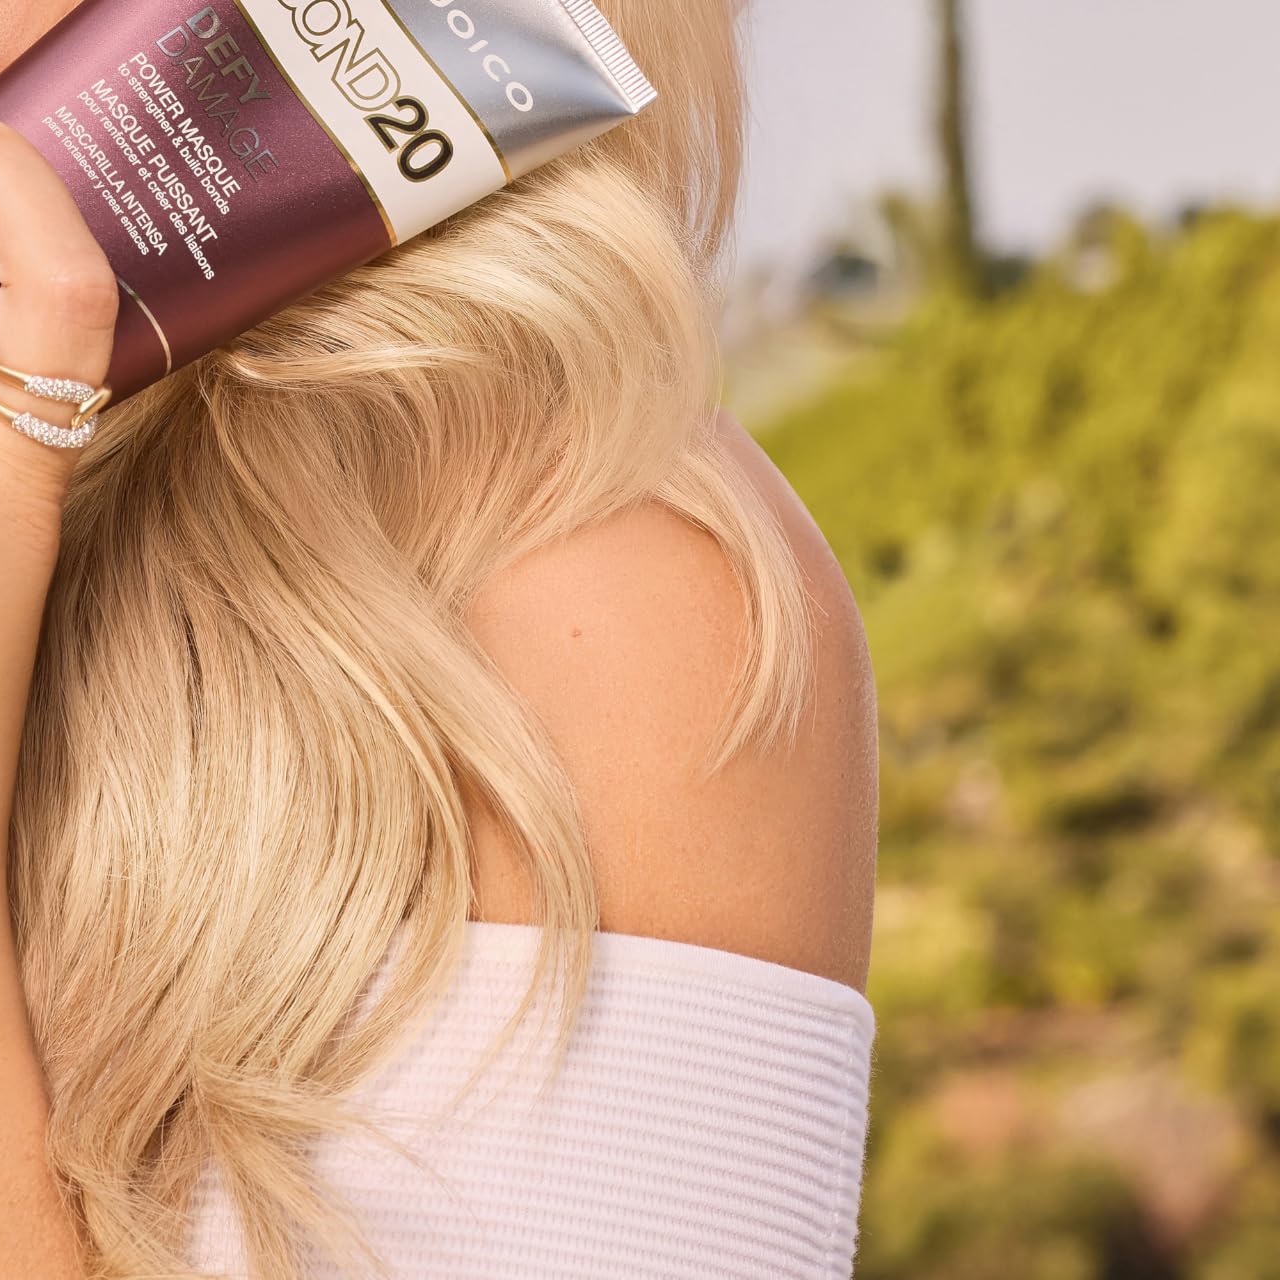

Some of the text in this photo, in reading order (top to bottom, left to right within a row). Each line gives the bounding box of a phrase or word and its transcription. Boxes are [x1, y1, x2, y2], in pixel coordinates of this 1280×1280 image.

[129, 52, 241, 198] POWER MASQUE
[155, 26, 280, 183] DAMAGE
[185, 6, 272, 104] DEFY
[42, 116, 150, 256] para fortalecer y crear enlaces
[55, 105, 168, 256] MASCARILLA INTENSA
[77, 90, 215, 281] pour renforcer et créer des liaisons
[91, 79, 218, 243] MASQUE PUISSANT
[118, 63, 230, 215] to strengthen & build bonds
